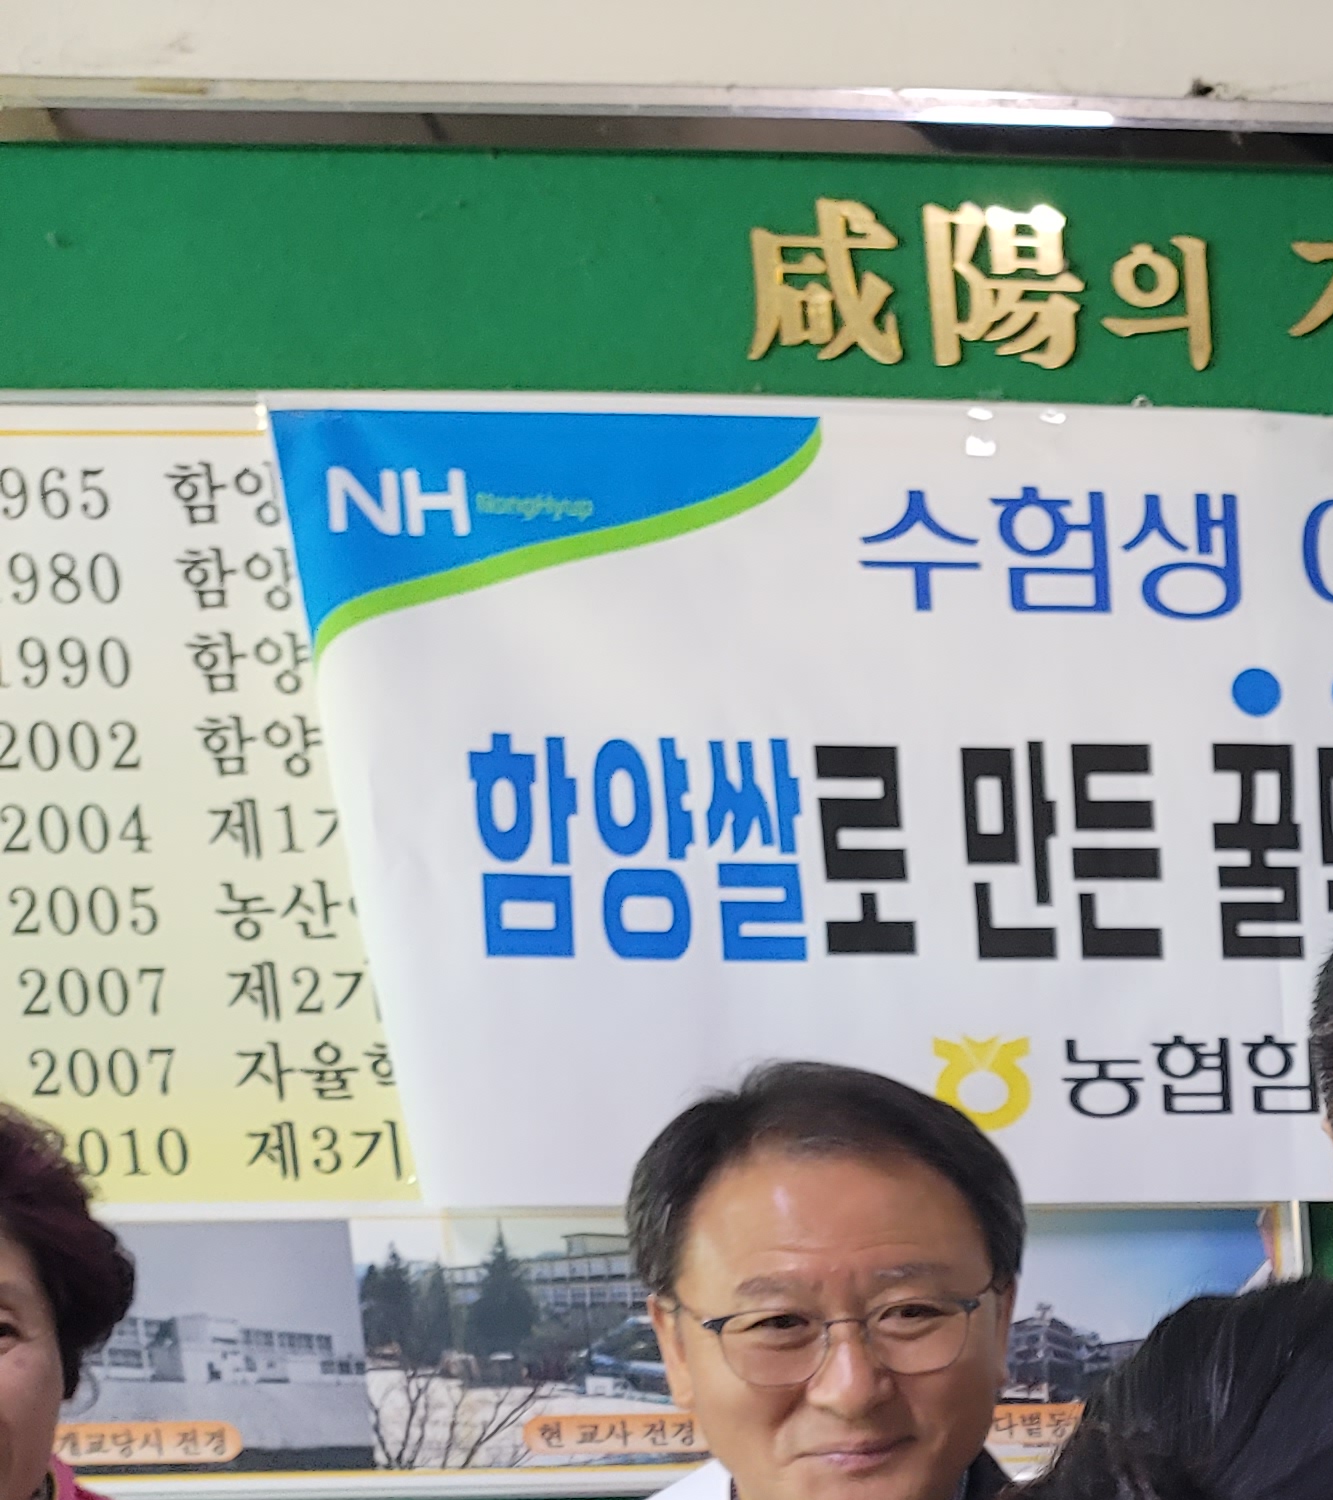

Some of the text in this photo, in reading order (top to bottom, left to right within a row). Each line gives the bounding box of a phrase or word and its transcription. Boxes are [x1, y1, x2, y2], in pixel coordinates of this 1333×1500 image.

[751, 197, 1213, 371] 咸陽의
[327, 468, 470, 536] NH
[861, 485, 1242, 620] 수험생
[185, 631, 312, 694] 함양
[0, 720, 143, 772] 2002
[195, 714, 325, 778] 함양
[0, 803, 152, 856] 2004
[467, 731, 916, 961] 함양쌀로
[959, 740, 1163, 960] 만든
[9, 886, 158, 936] 2005
[215, 879, 357, 942] 농산
[18, 966, 166, 1018] 2007
[28, 1046, 177, 1098] 2007
[76, 1127, 190, 1178] 010
[246, 1119, 403, 1183] 제3기
[576, 1420, 634, 1447] 교사
[643, 1419, 697, 1447] 전경
